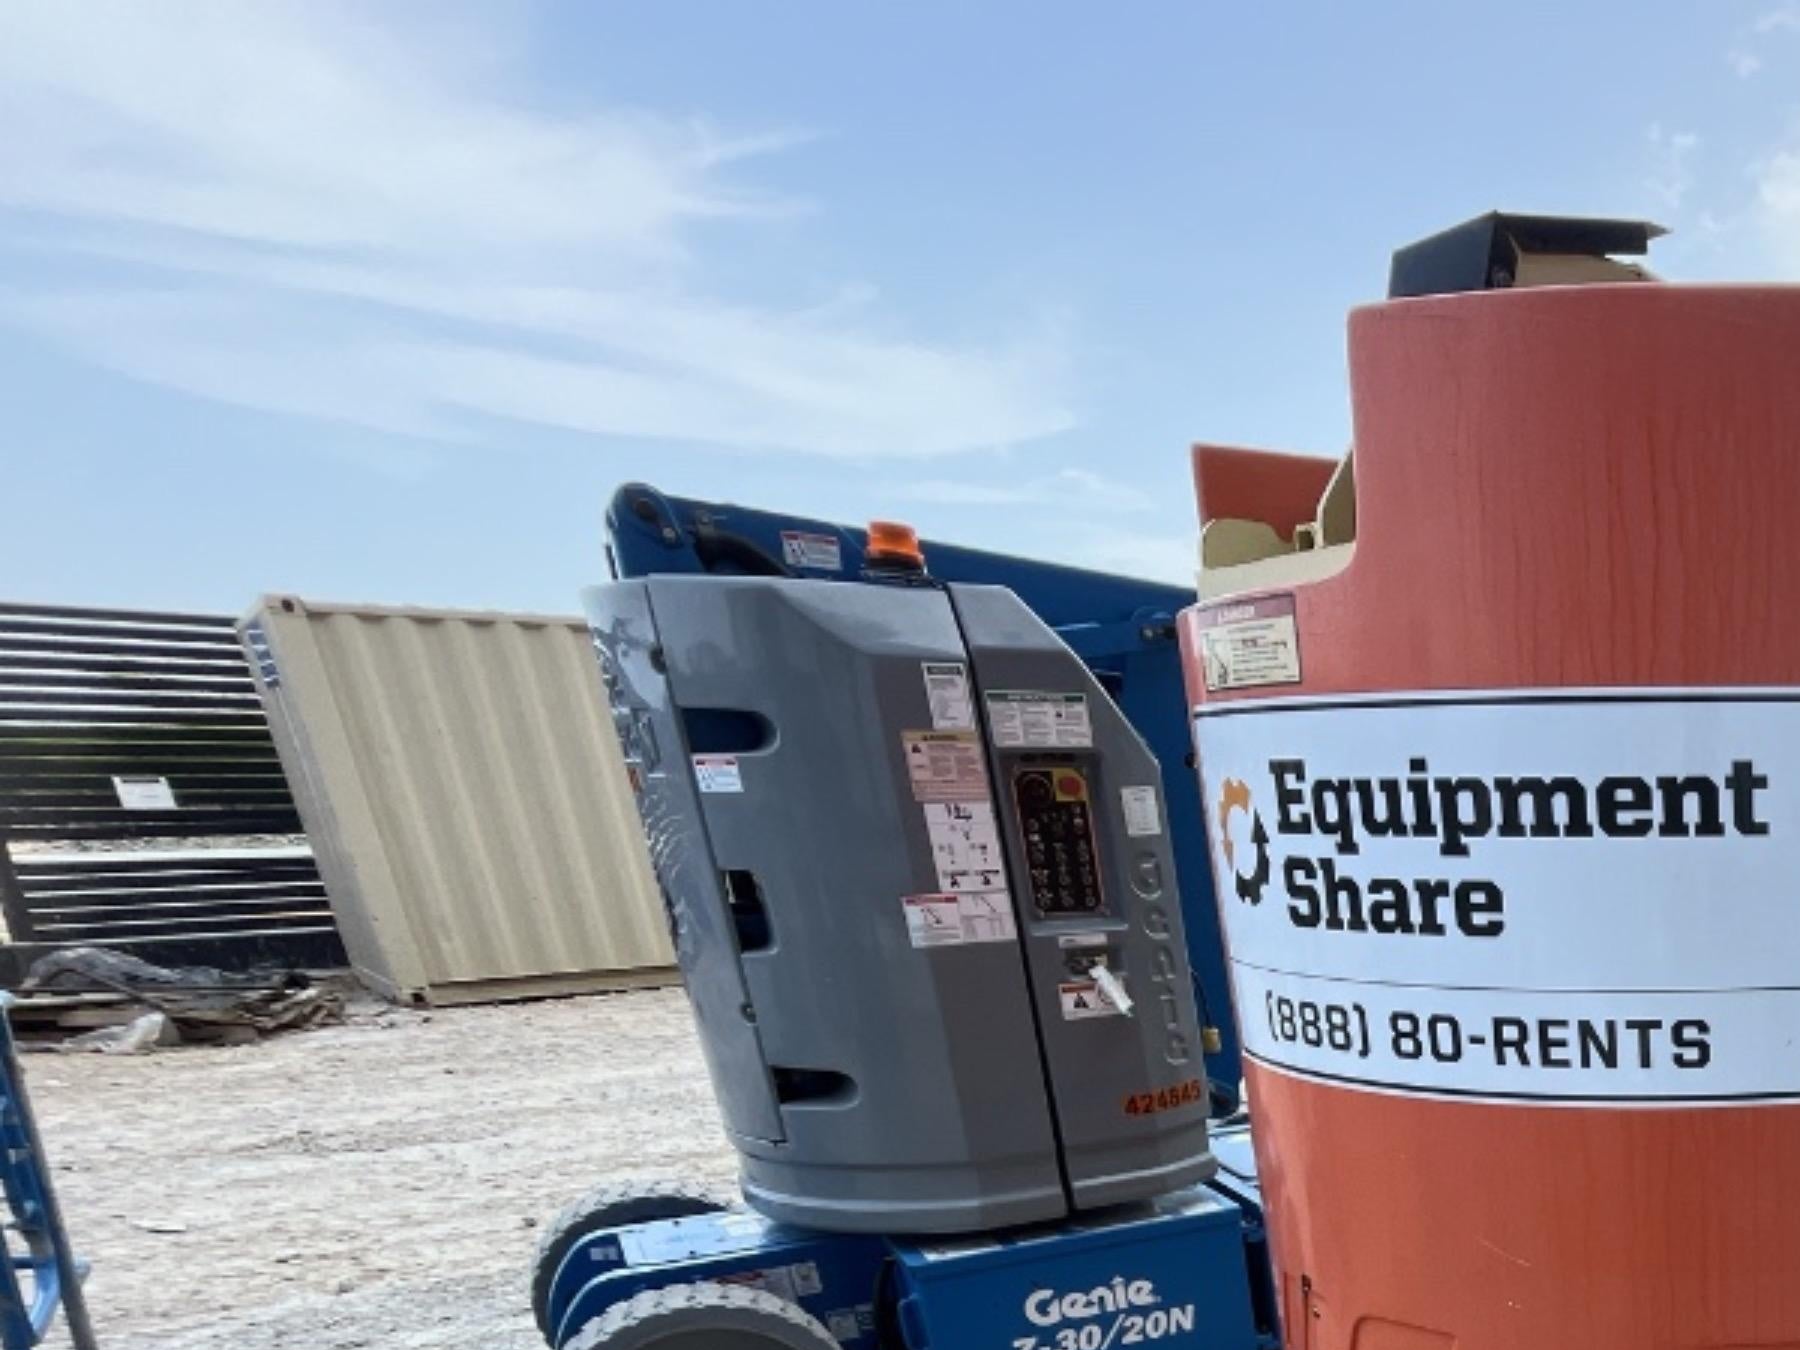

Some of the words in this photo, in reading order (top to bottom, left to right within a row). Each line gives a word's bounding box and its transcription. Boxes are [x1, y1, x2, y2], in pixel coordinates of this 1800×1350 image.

[1269, 757, 1769, 856] Equipment
[1284, 856, 1505, 937] Share
[1266, 990, 1369, 1057] (888)
[1391, 1012, 1713, 1070] 80-RENTS
[1025, 1275, 1159, 1326] Genie
